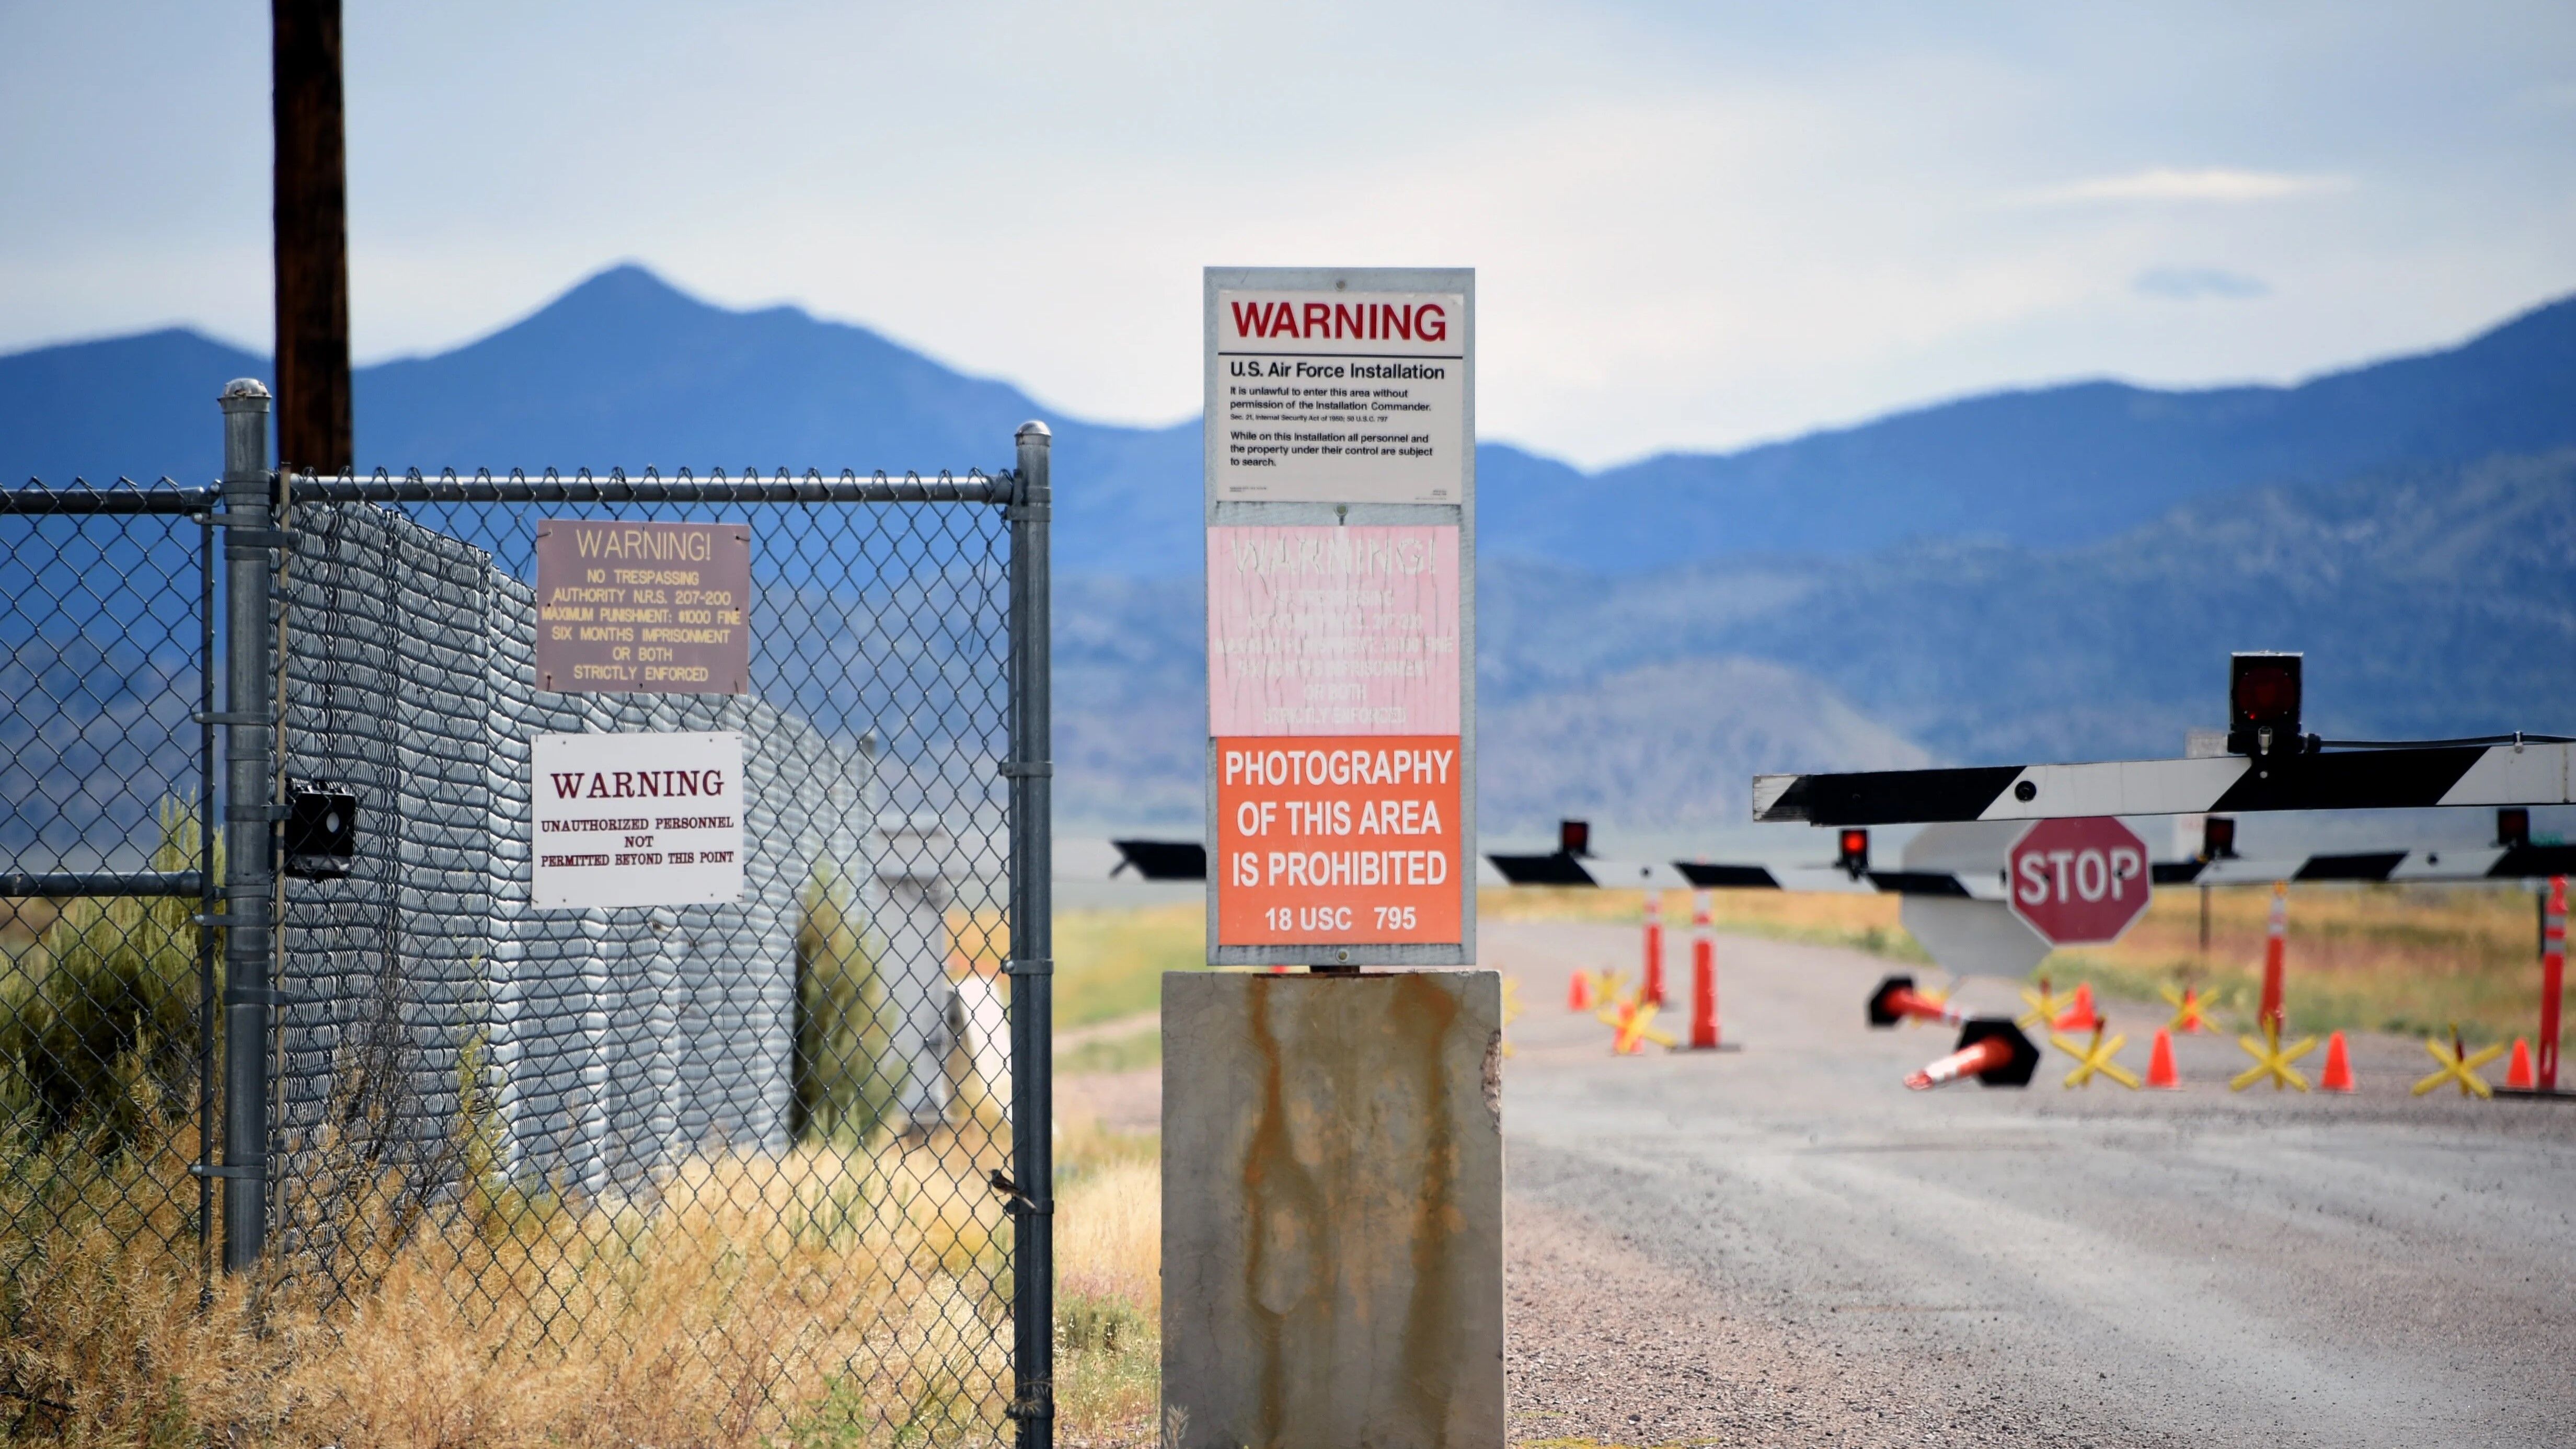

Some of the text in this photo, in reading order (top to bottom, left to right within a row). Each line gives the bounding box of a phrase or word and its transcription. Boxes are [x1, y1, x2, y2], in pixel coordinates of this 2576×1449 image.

[1230, 301, 1446, 341] WARNING
[1230, 361, 1444, 380] U.S. Air Force Installation
[1230, 386, 1409, 398] It is unlawful to enter this area without
[1230, 400, 1432, 411] permission of the Installation Commander.
[1230, 431, 1257, 441] While
[1274, 432, 1291, 441] this
[1294, 433, 1346, 442] Installation
[1348, 433, 1358, 442] all
[1361, 434, 1408, 444] personnel
[1411, 434, 1429, 443] and
[1230, 445, 1245, 453] the
[1247, 445, 1289, 456] property
[1291, 446, 1319, 454] under
[1321, 446, 1343, 454] their
[1345, 446, 1378, 455] control
[1398, 447, 1433, 458] subject
[1242, 458, 1276, 466] search.
[576, 529, 711, 561] WARNING!
[1230, 537, 1436, 576] WARNING!
[587, 569, 699, 585] NO TRESPASSING
[554, 587, 731, 606] AUTHORITY N.R.S. 207-200
[541, 606, 594, 622] MAXIMUM
[600, 607, 672, 623] PUNISHMENT:
[717, 610, 741, 625] FINE
[552, 625, 731, 644] SIX MONTHS IMPRISONMENT
[613, 647, 673, 662] OR BOTH
[574, 664, 708, 682] STRICTLY ENFORCED
[1225, 750, 1453, 786] PHOTOGRAPHY
[550, 769, 724, 799] WARNING
[541, 816, 734, 832] UNAUTHORIZED PERSONNEL
[1237, 800, 1442, 836] OF THIS AREA
[624, 836, 654, 847] NOT
[541, 851, 734, 867] PERMITTED BEYOND THIS POINT
[1233, 851, 1447, 887] IS PROHIBITED
[2018, 847, 2141, 906] STOP
[1265, 906, 1417, 932] 18 USC 795
